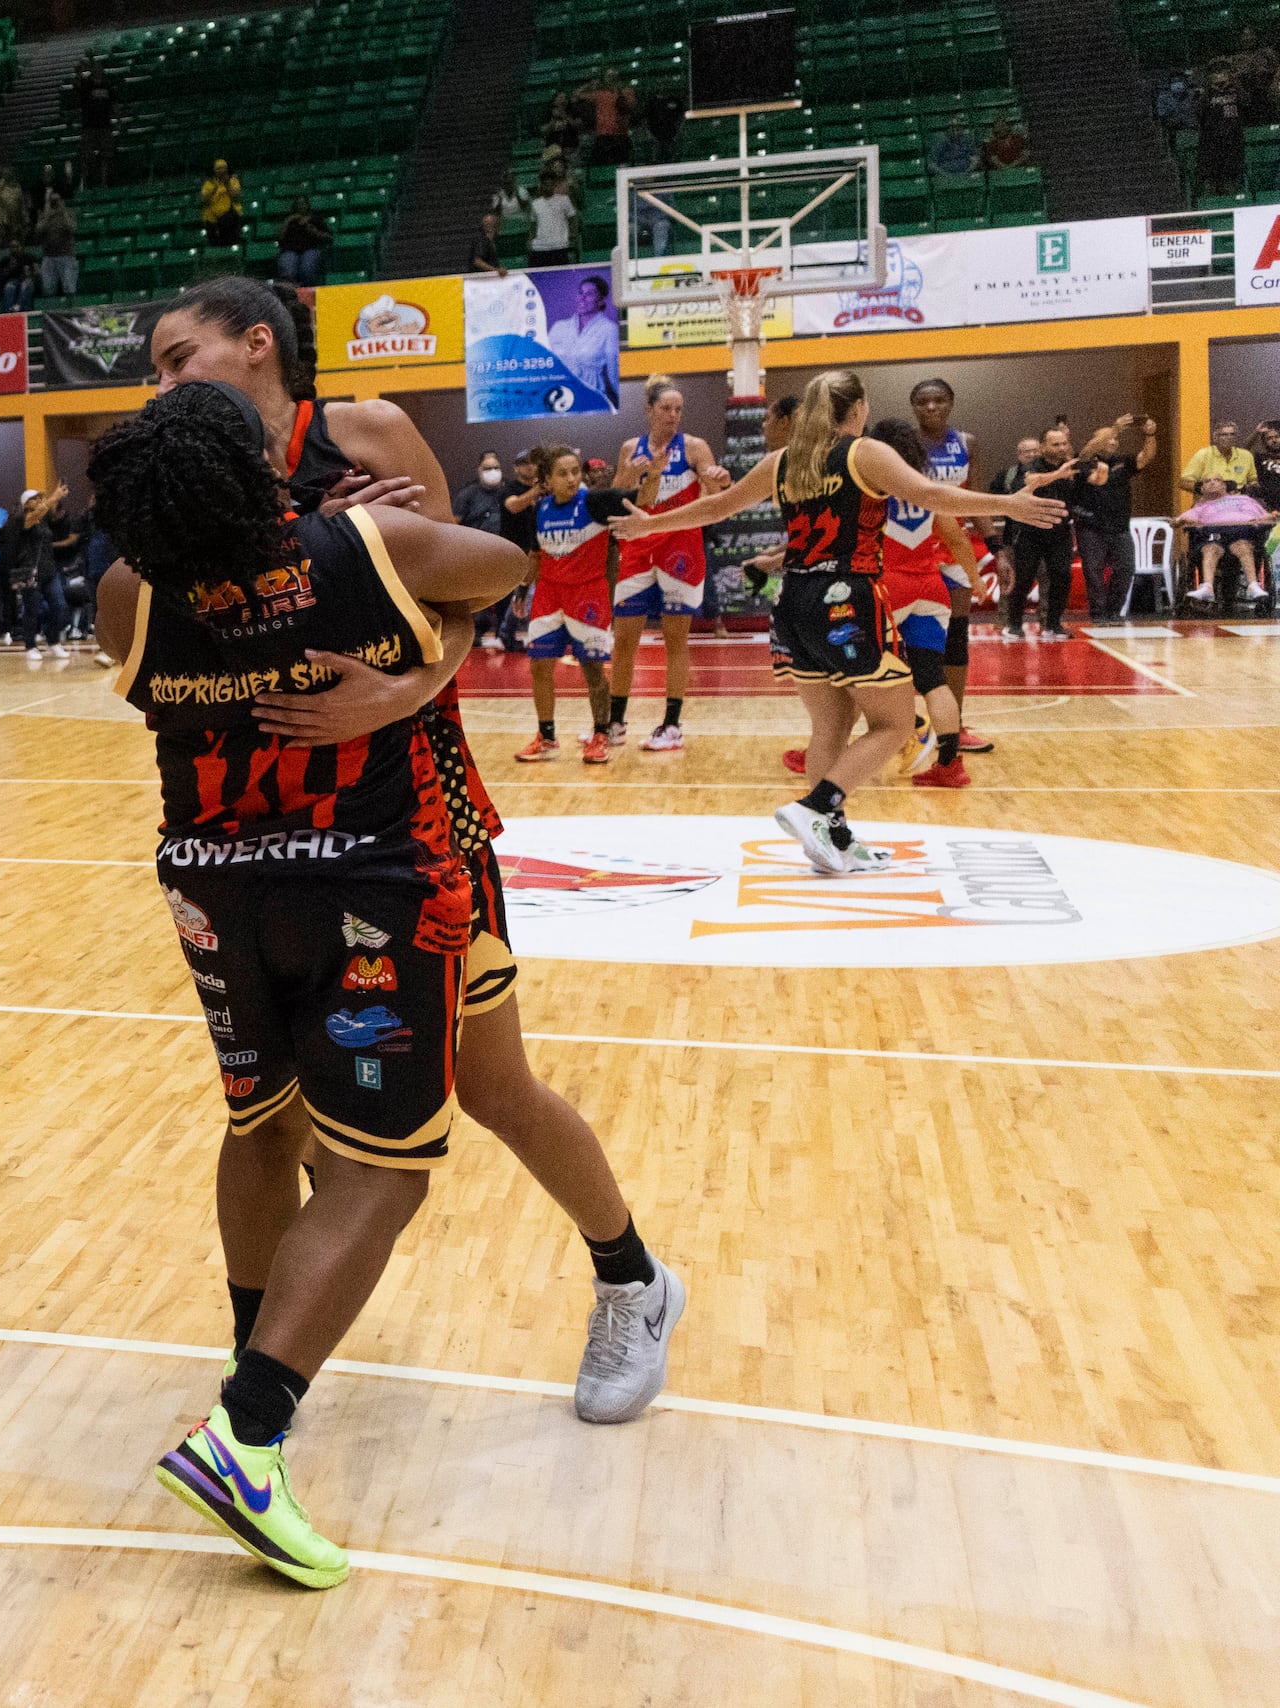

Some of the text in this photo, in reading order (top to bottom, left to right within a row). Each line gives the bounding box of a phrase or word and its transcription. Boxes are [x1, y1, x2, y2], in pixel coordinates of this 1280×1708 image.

[1151, 235, 1205, 248] GENERAL
[1166, 248, 1190, 259] SUR
[974, 271, 1138, 291] EMBASSY SUITES
[1020, 288, 1082, 299] HOTELS
[833, 305, 925, 327] CUERO
[351, 337, 432, 357] KIKUET
[787, 505, 841, 567] 22
[241, 590, 317, 624] FIRE
[222, 616, 295, 639] LOUNGE
[148, 667, 284, 706] RODRIGUEZ
[157, 829, 376, 867] POWERAD
[348, 972, 394, 986] marco's
